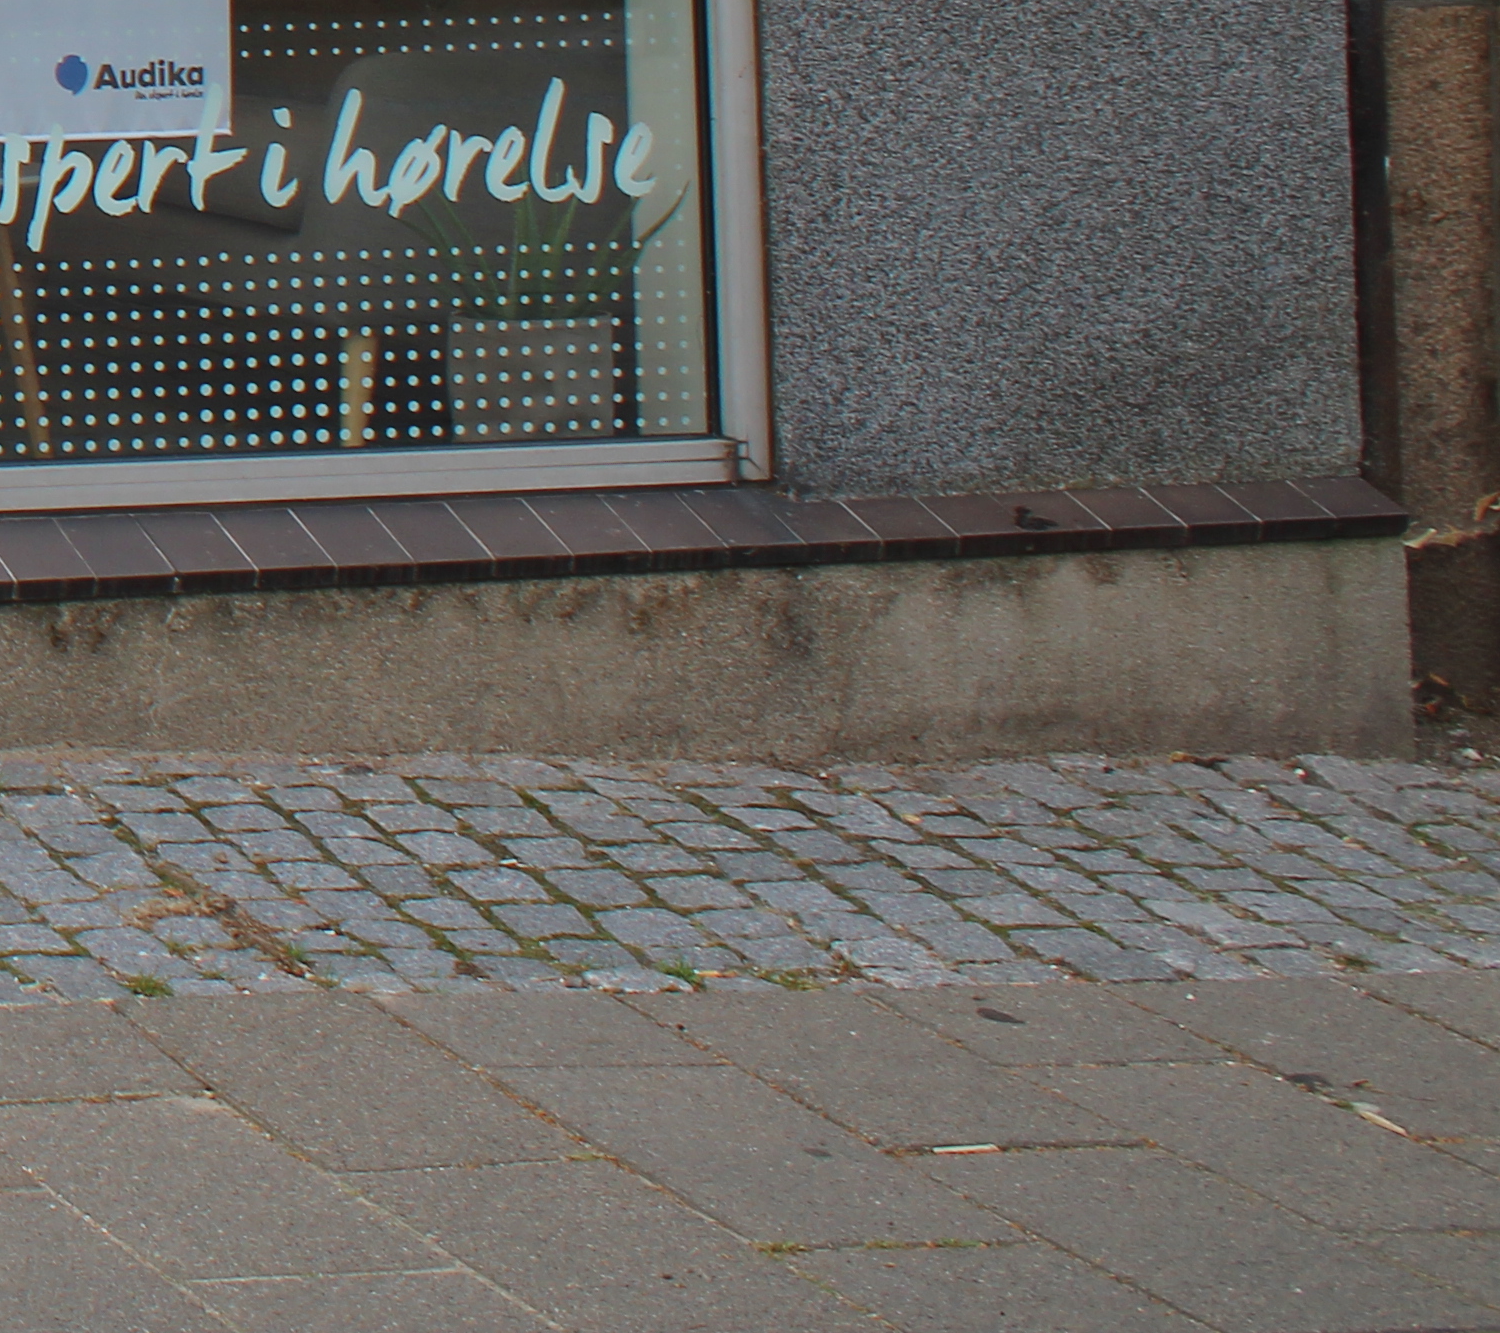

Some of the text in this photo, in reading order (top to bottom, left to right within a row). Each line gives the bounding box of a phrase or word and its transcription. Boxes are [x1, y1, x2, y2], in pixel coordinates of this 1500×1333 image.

[93, 59, 204, 90] Audika
[258, 105, 299, 210] i
[323, 76, 658, 218] hørelse
